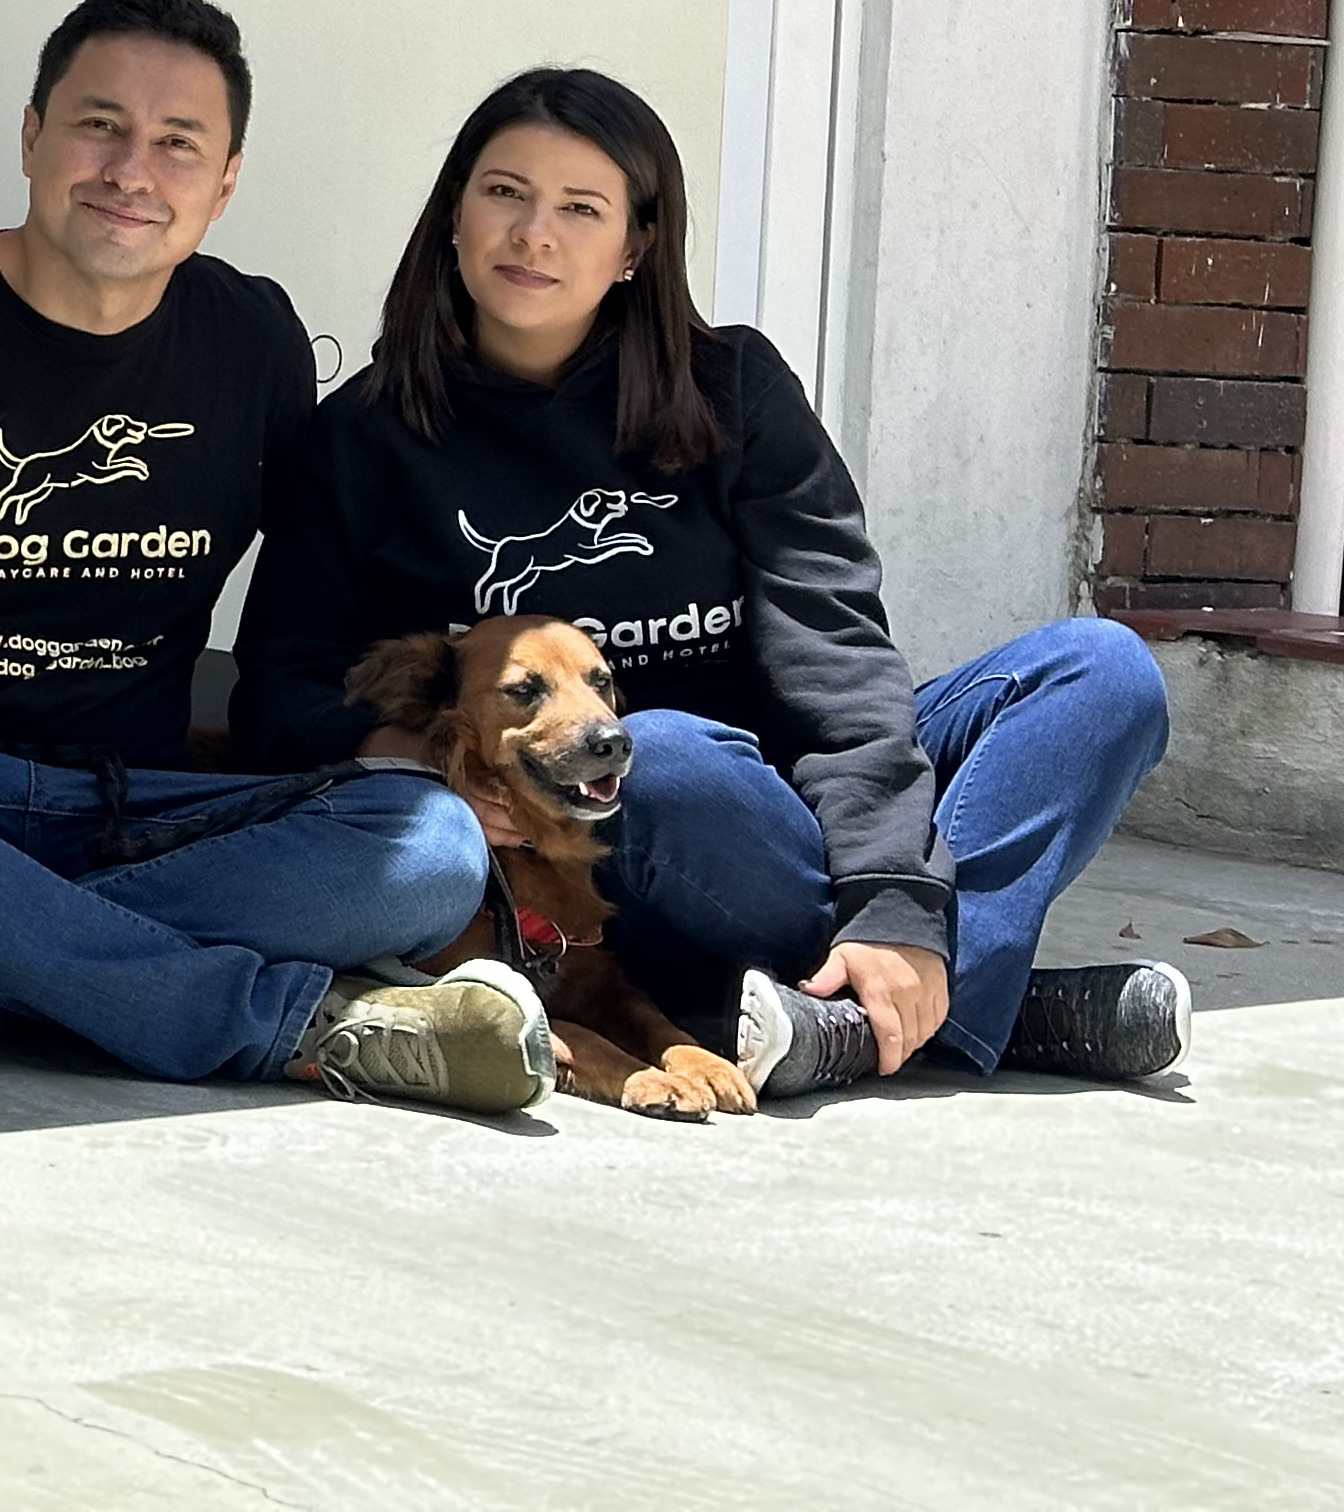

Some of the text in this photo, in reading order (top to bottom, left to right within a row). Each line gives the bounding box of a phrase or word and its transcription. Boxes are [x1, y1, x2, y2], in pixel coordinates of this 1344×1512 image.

[62, 525, 211, 559] Garden
[81, 567, 119, 579] AND
[130, 566, 186, 580] HOTEL
